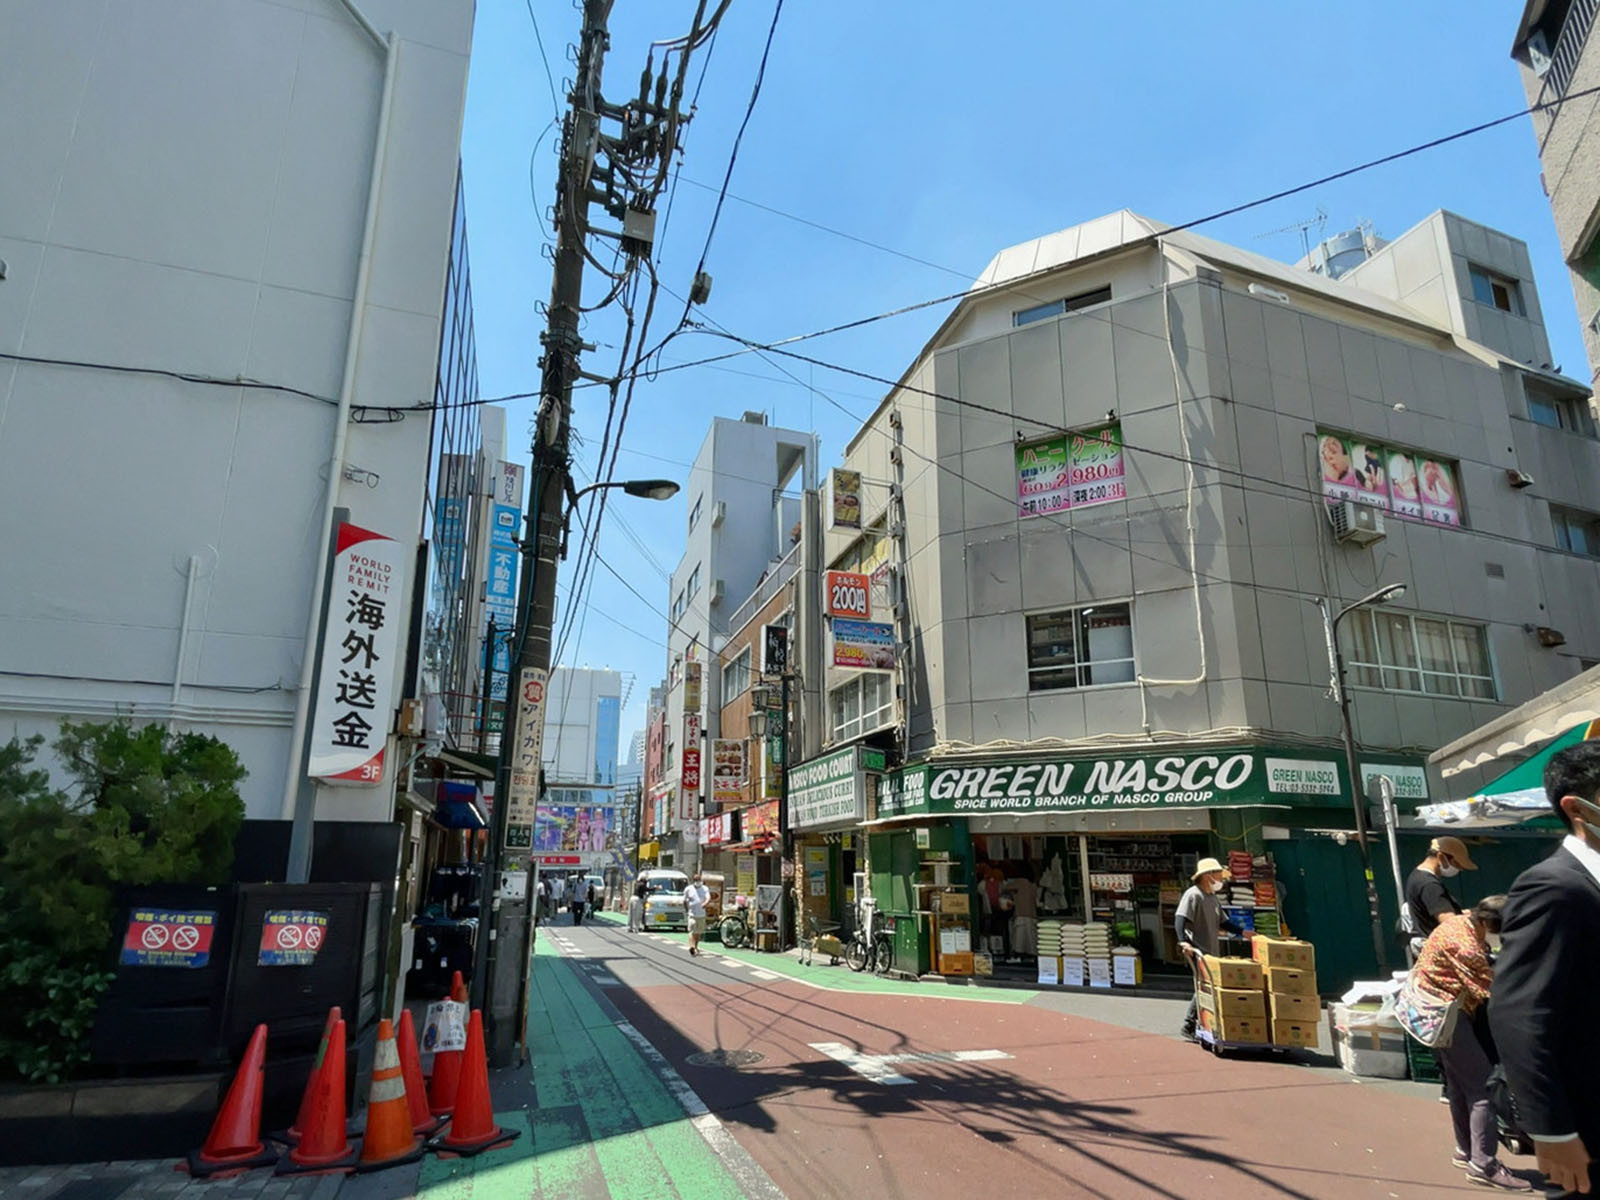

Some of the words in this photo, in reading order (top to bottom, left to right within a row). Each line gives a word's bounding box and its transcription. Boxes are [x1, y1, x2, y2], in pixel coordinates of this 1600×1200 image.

[350, 553, 392, 573] WORLD
[493, 551, 512, 594] 不動産
[349, 564, 391, 583] FAMILY
[348, 575, 390, 594] REMIT
[832, 586, 866, 614] 200円
[331, 589, 387, 750] 海外送金
[522, 703, 538, 767] アイカワ
[360, 764, 380, 780] 3F
[809, 762, 828, 784] FOOD
[829, 754, 853, 778] COURT
[930, 763, 1075, 800] GREEN
[1084, 754, 1254, 795] NASCO
[1272, 768, 1302, 782] GREEN
[1305, 770, 1335, 783] NASCO
[903, 771, 924, 792] FOOD
[1396, 775, 1422, 787] NASCO
[954, 797, 988, 810] SPICE
[990, 796, 1031, 808] WORLD
[1034, 795, 1086, 807] BRANCH
[1091, 794, 1109, 805] OF
[1113, 793, 1159, 804] NASCO
[1164, 791, 1213, 803] GROUP
